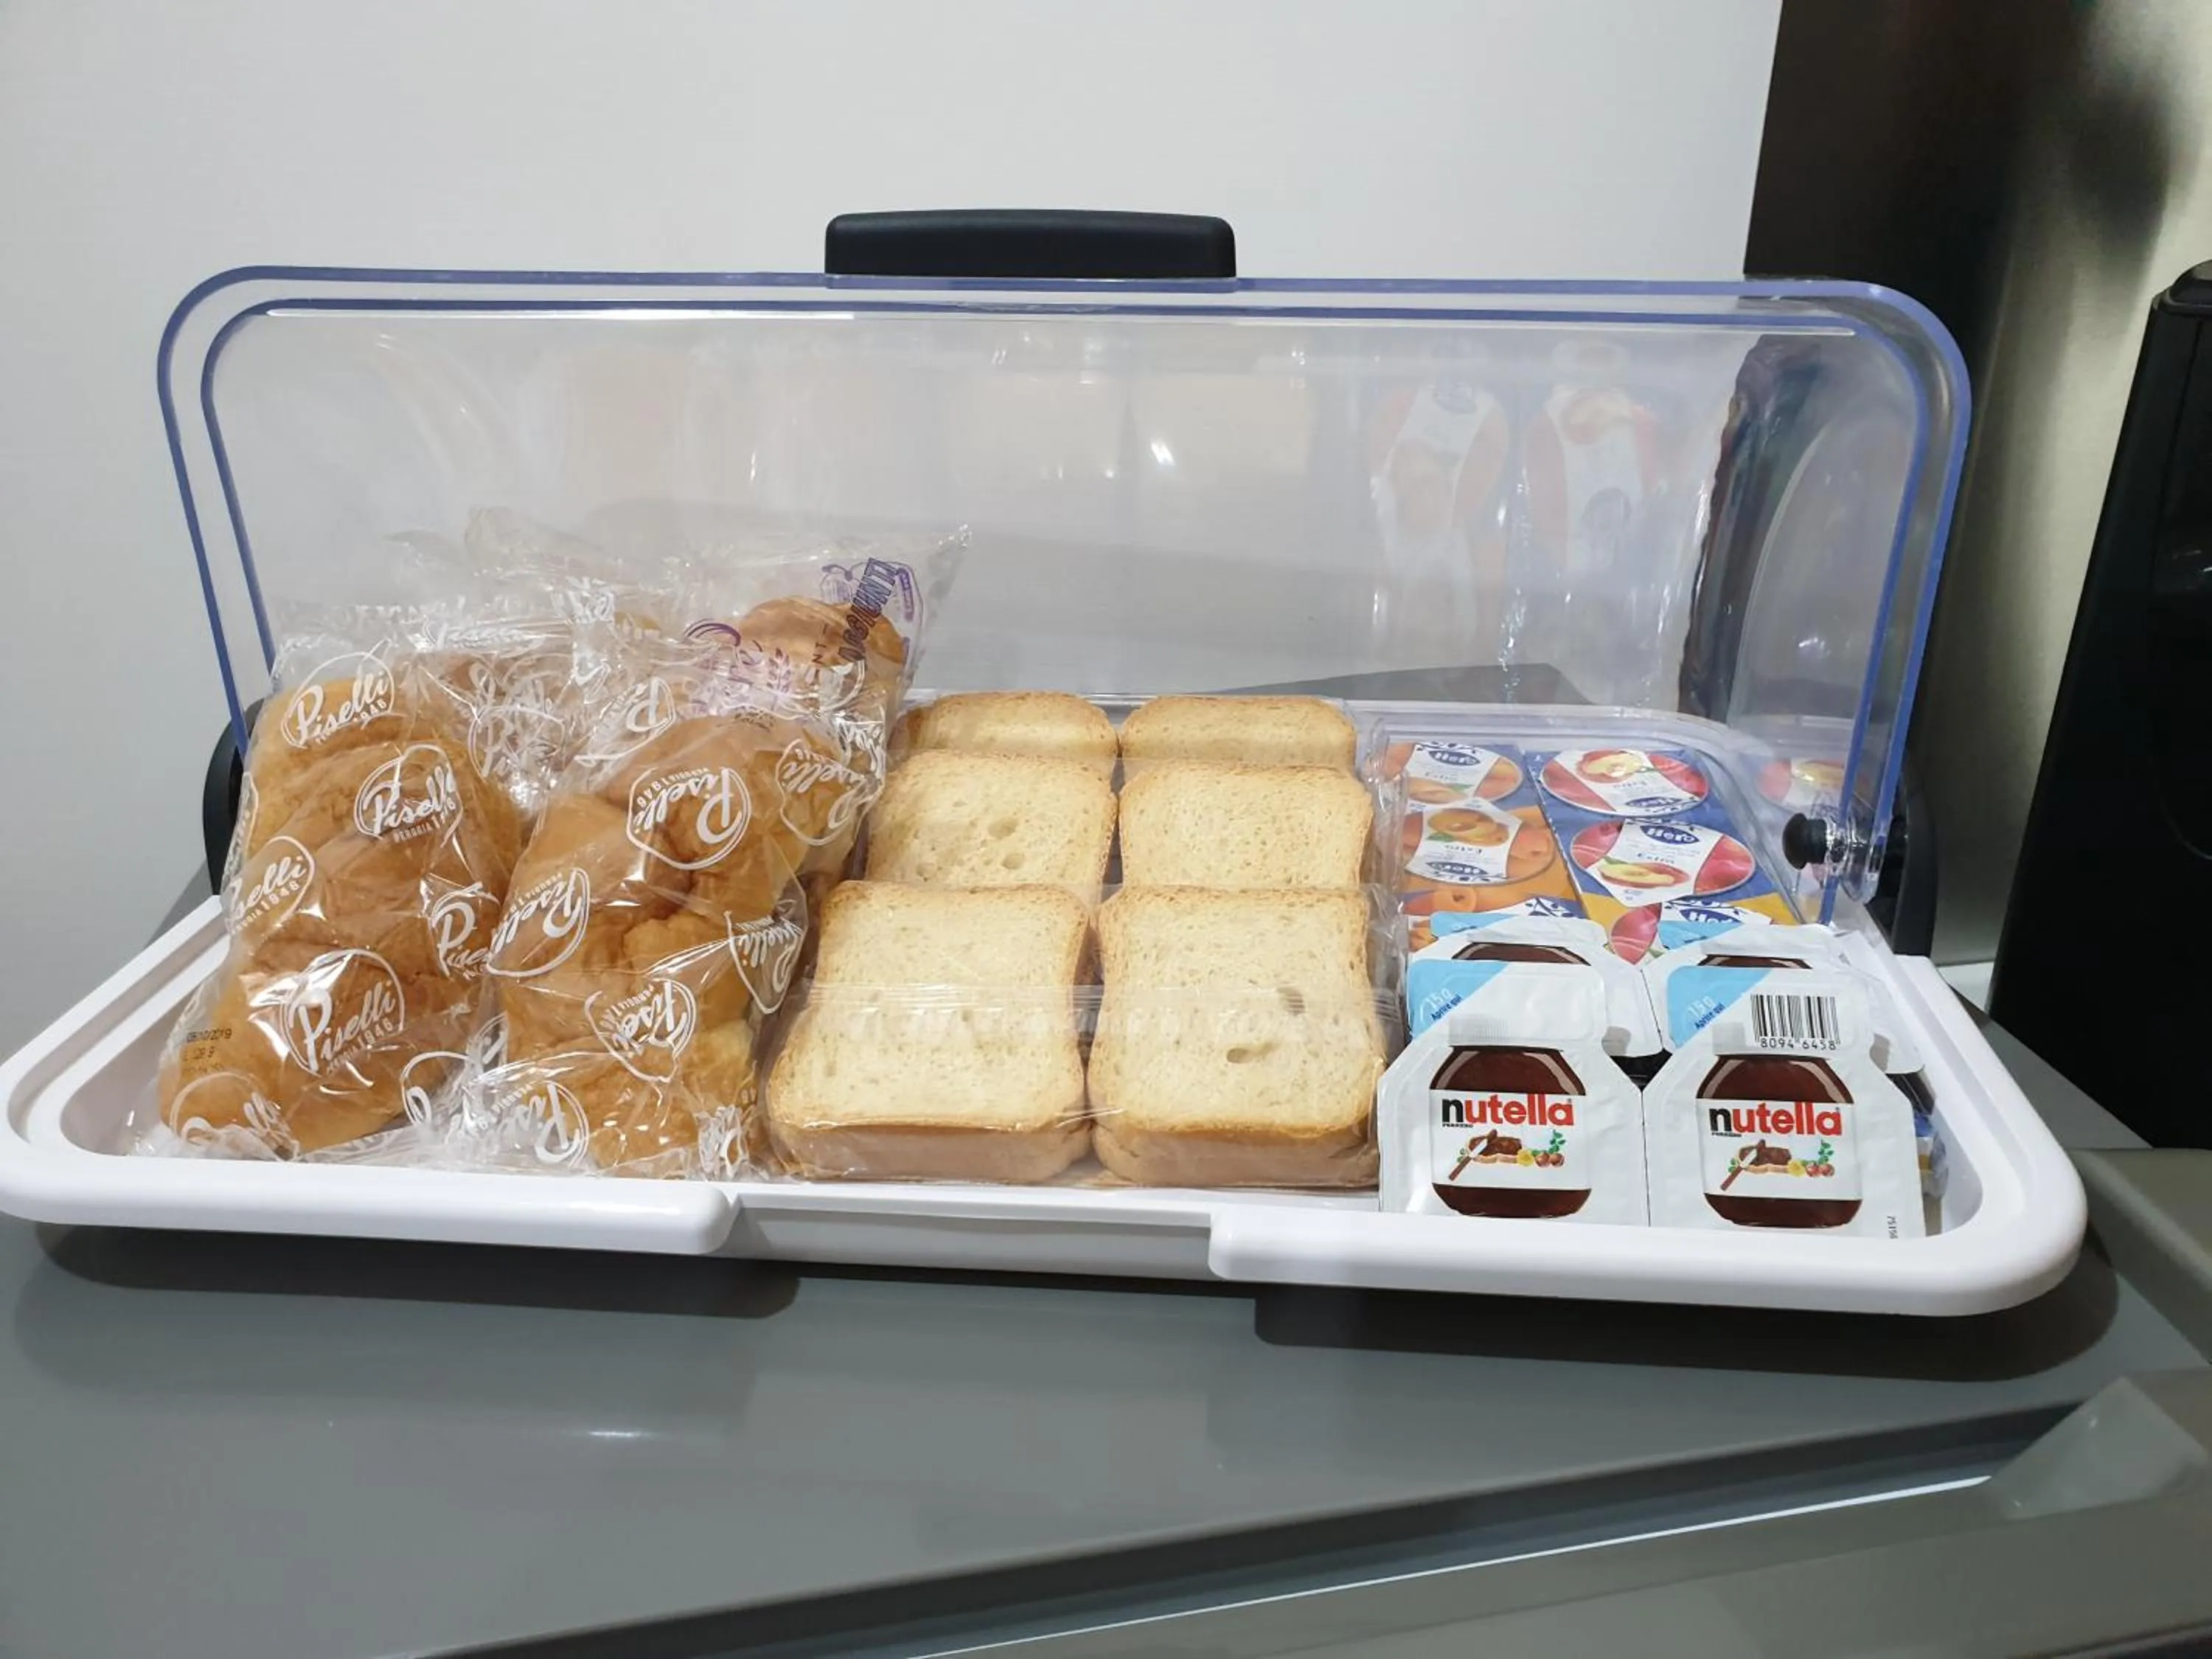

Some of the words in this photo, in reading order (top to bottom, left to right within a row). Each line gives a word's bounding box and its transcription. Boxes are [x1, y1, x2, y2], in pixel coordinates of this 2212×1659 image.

[288, 672, 389, 746] Piselli
[633, 768, 743, 845] Piselli
[1646, 827, 1696, 844] Hero
[288, 981, 397, 1073] Piselli
[1760, 1037, 1794, 1048] 8094
[1442, 1094, 1574, 1126] nutella
[1709, 1102, 1842, 1135] nutella
